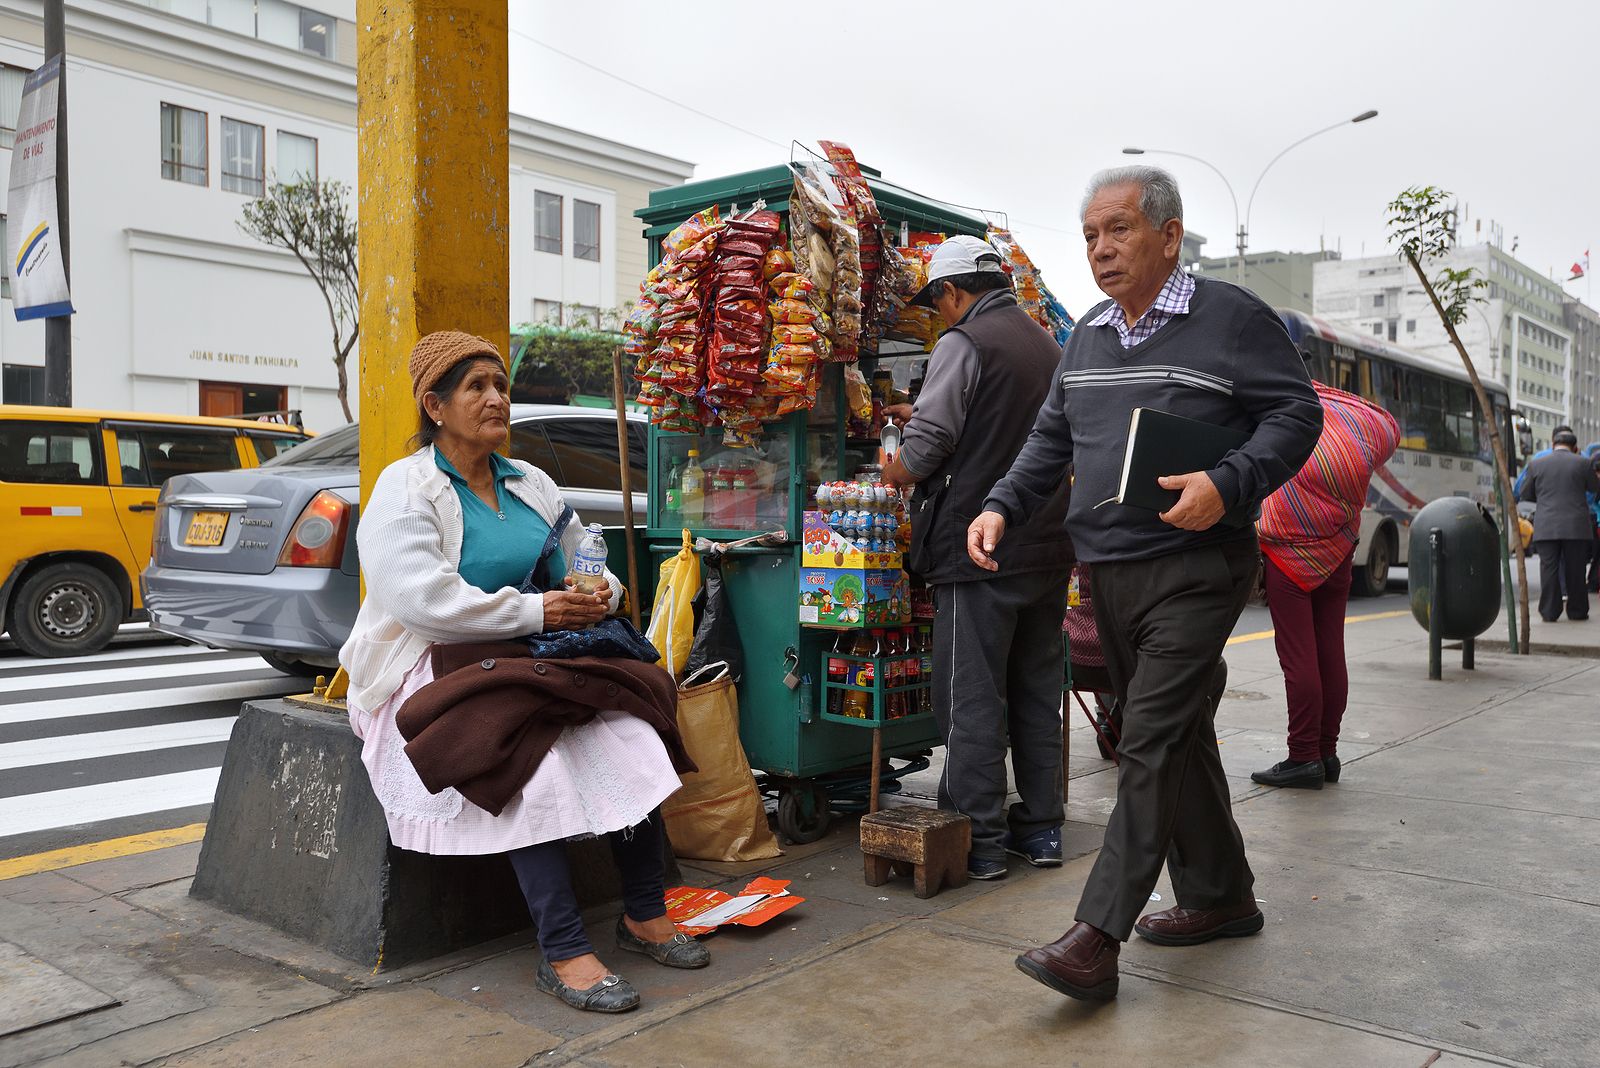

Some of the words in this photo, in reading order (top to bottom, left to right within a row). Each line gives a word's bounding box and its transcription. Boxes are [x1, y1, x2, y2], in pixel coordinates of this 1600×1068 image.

[23, 146, 31, 160] DE
[189, 350, 213, 361] JUAN
[217, 351, 250, 365] SANTOS
[254, 355, 299, 369] ATAHUALPA
